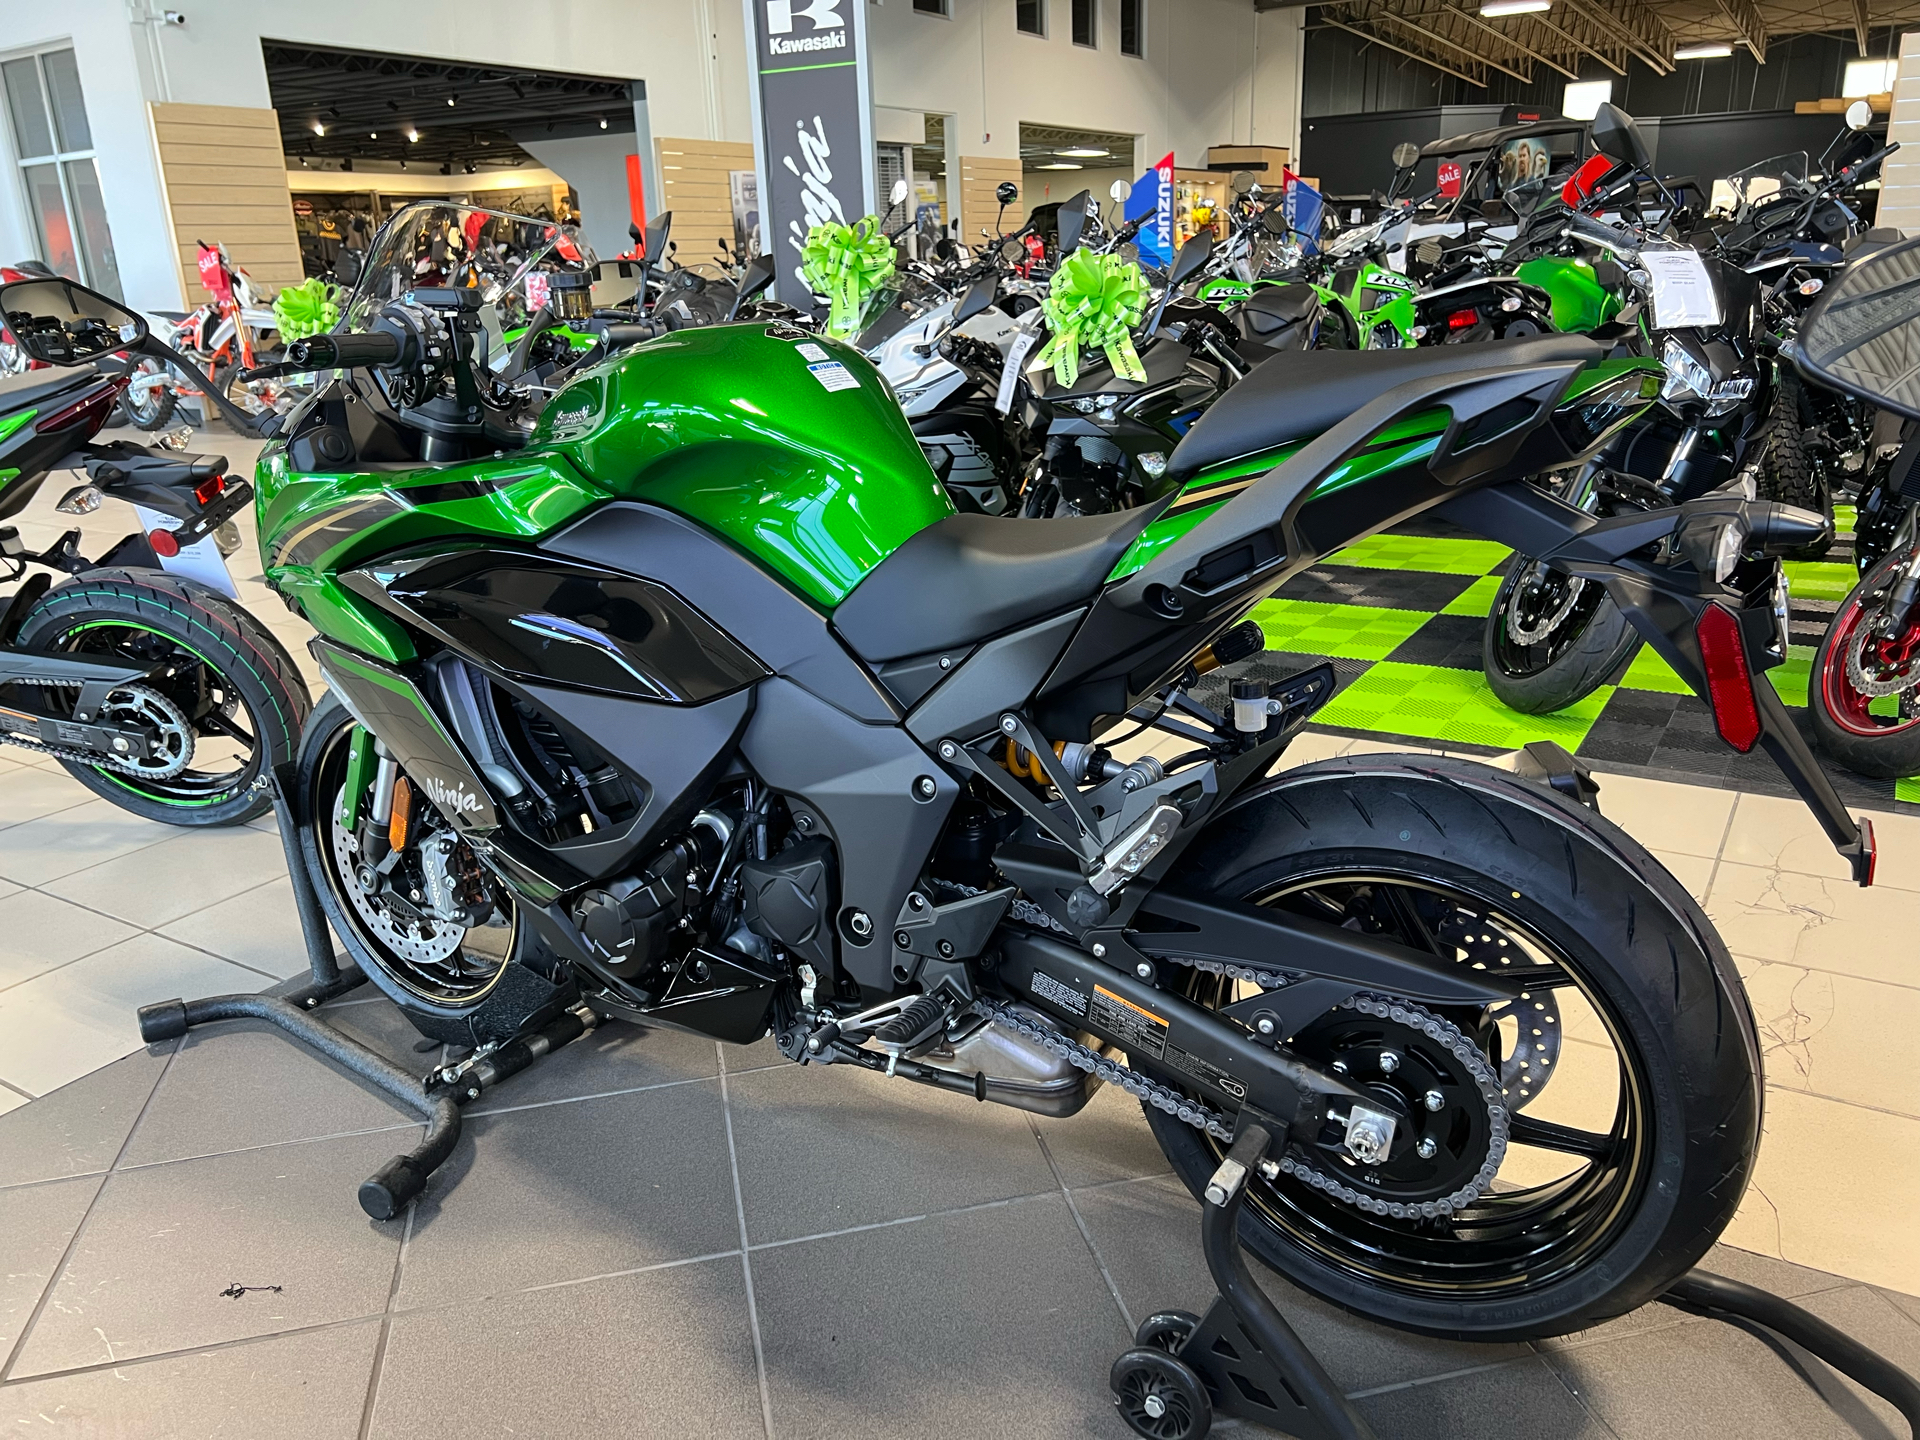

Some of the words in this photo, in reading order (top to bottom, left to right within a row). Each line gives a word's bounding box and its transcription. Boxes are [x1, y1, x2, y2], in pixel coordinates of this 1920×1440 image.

[768, 30, 846, 55] Kawasaki
[1438, 169, 1461, 185] SALE
[1157, 166, 1172, 248] SUZUKI
[198, 251, 218, 274] SALE
[1214, 287, 1252, 296] KLX
[1374, 275, 1413, 289] KLX
[1115, 338, 1136, 381] Kawasaki
[427, 777, 484, 815] Ninja
[426, 860, 442, 907] brembo
[1363, 1174, 1380, 1185] DID
